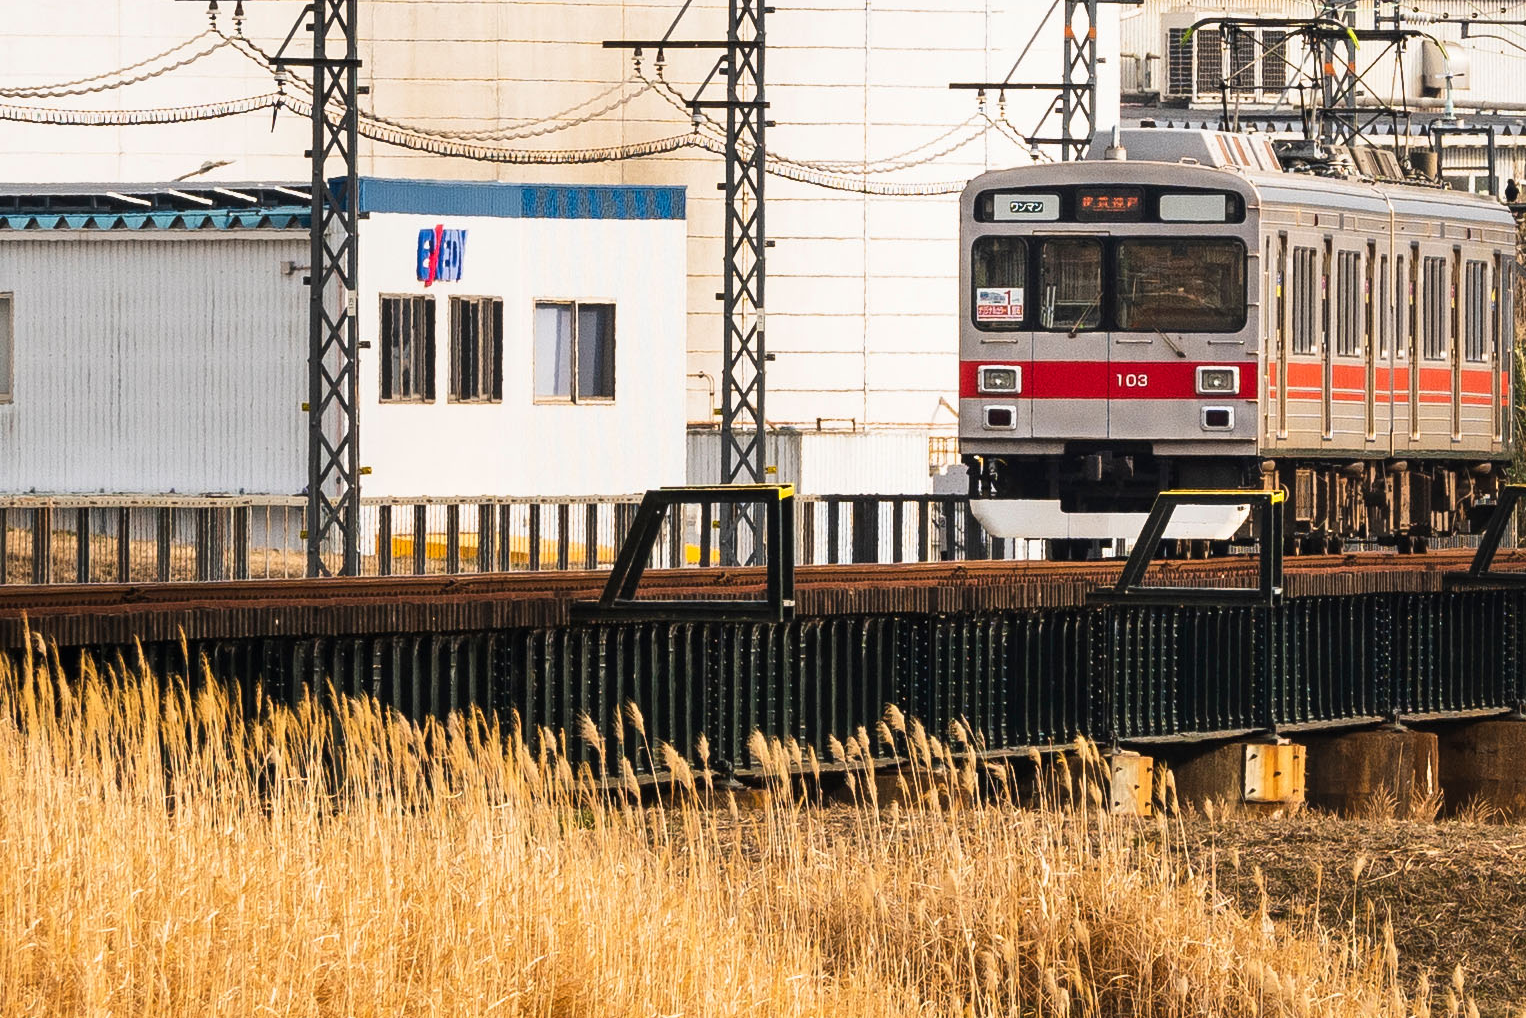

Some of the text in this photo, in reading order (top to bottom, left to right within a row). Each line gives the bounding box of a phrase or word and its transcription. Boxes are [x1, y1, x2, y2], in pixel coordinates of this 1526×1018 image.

[1010, 202, 1043, 212] ワンマン
[1116, 373, 1148, 387] 103
